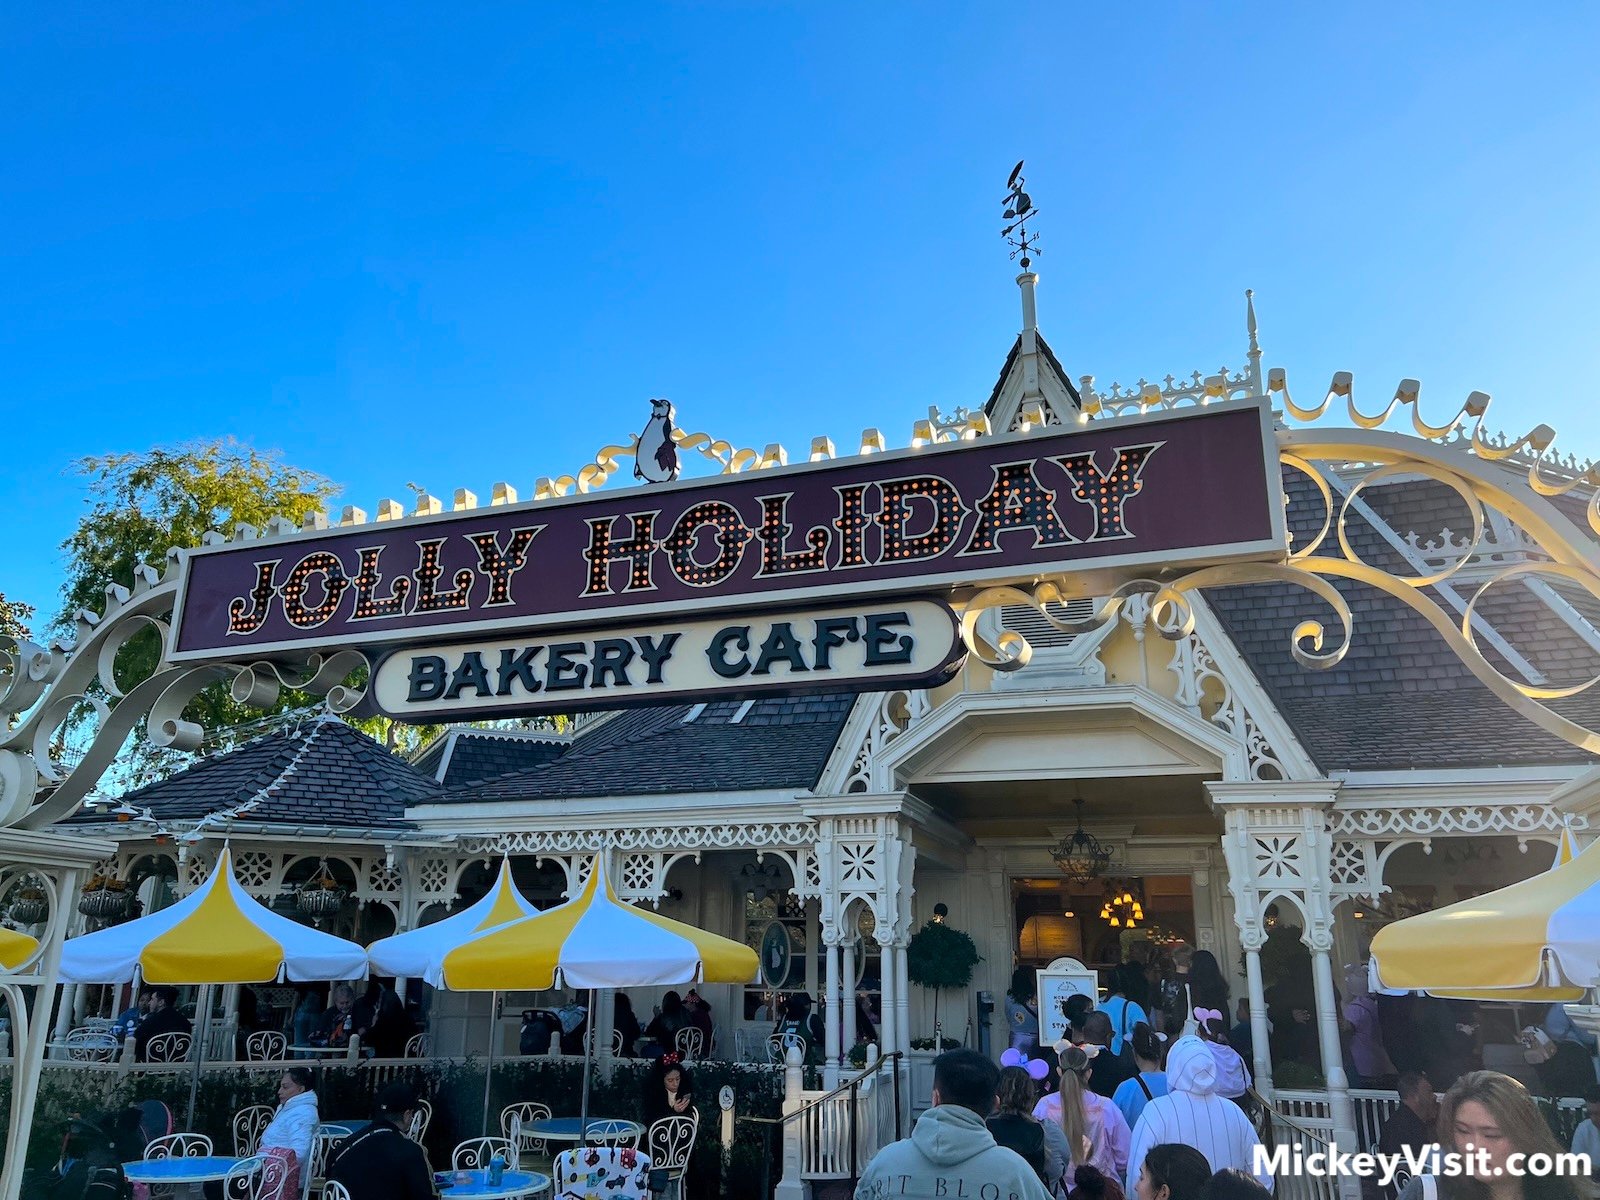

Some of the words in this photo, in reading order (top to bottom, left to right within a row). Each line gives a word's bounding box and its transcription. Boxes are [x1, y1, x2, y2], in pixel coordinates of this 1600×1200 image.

[225, 524, 548, 636] JOLLY
[578, 440, 1168, 598] HOLIDAY
[406, 632, 683, 703] BAKERY
[705, 611, 915, 679] CAFE
